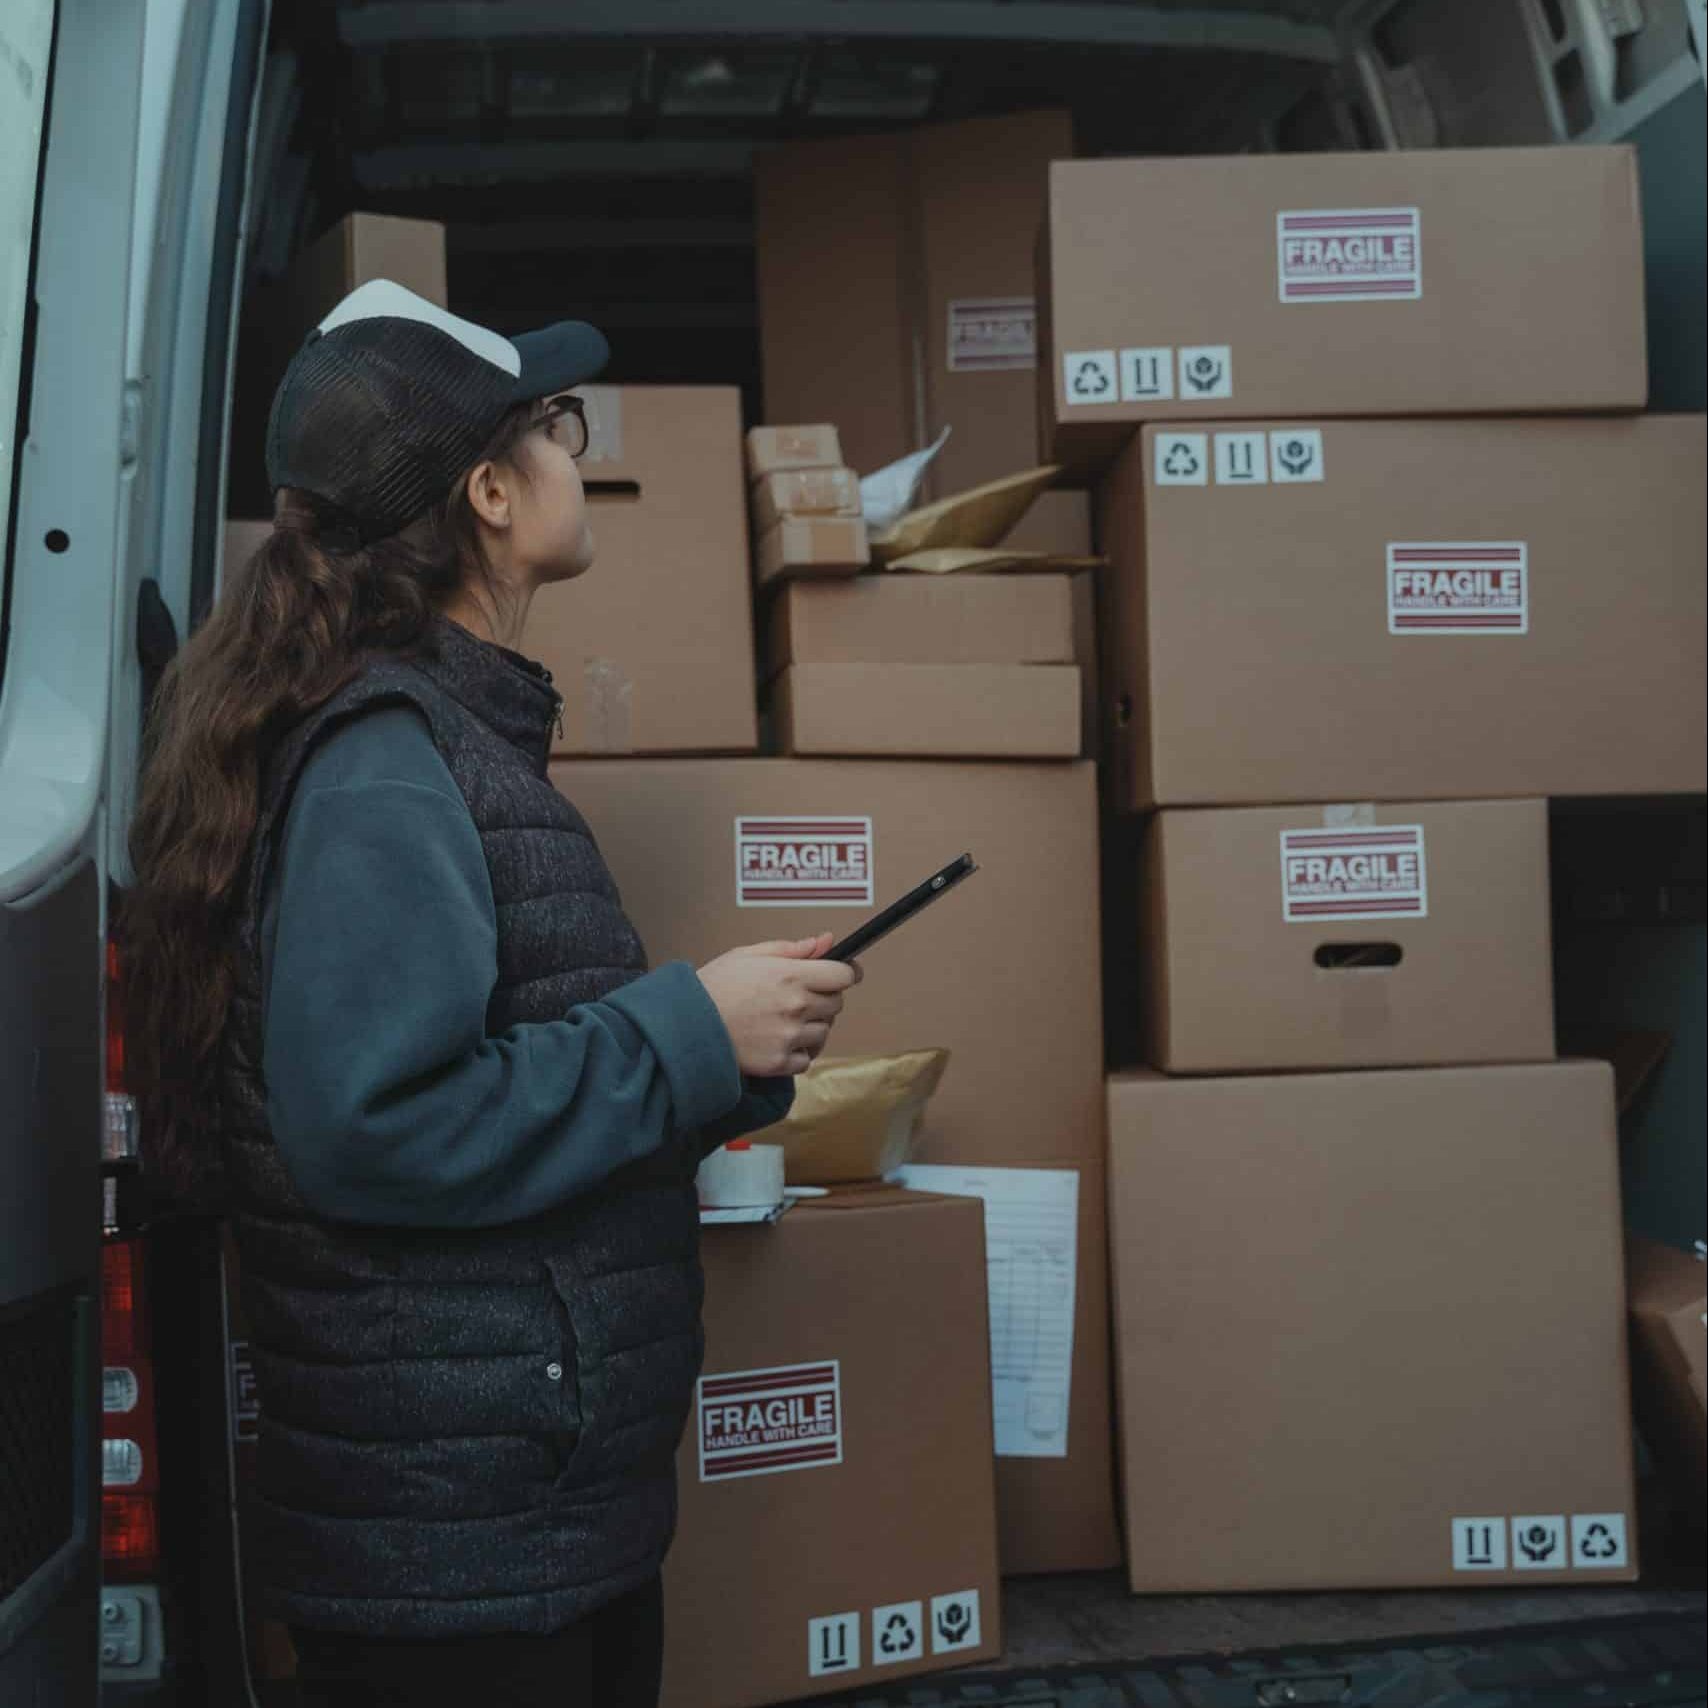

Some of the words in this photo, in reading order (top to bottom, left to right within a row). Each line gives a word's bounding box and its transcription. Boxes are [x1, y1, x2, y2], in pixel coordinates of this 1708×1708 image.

[1286, 237, 1411, 264] FRAGILE
[1395, 571, 1520, 597] FRAGILE
[744, 844, 865, 869] FRAGILE
[1288, 854, 1417, 883] FRAGILE
[705, 1394, 833, 1436] FRAGILE
[705, 1430, 760, 1449] HANDLE
[763, 1426, 796, 1442] WITH
[798, 1420, 833, 1437] CARE
